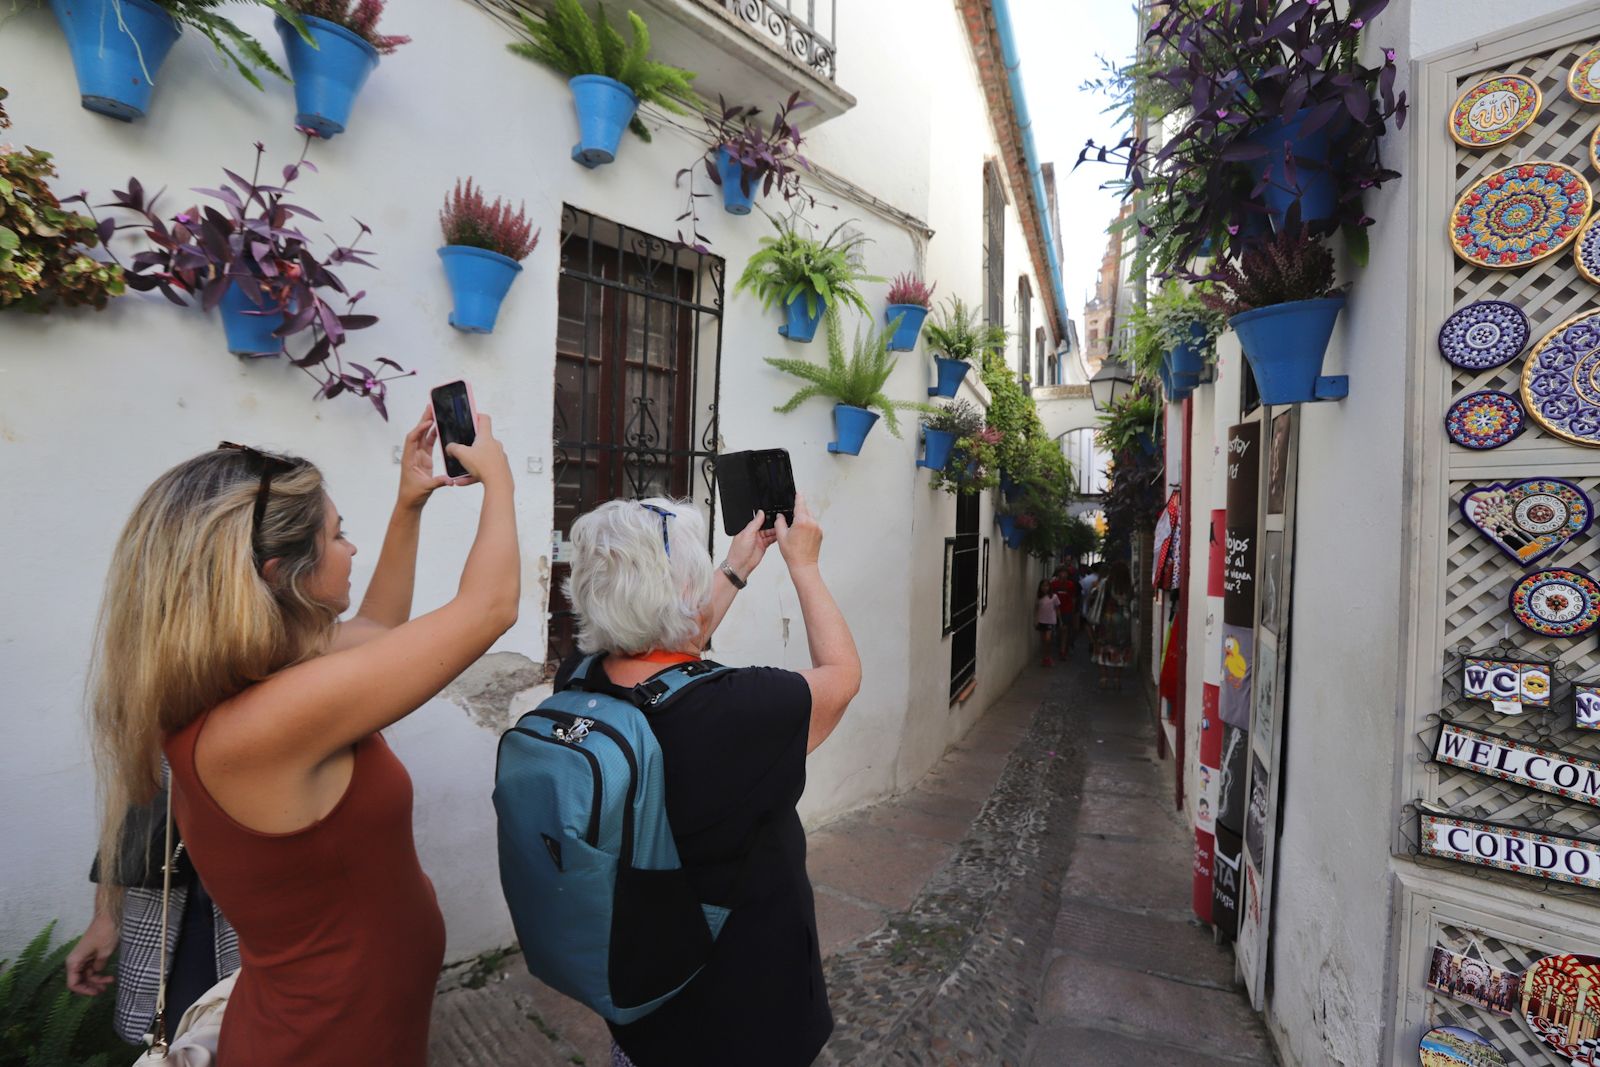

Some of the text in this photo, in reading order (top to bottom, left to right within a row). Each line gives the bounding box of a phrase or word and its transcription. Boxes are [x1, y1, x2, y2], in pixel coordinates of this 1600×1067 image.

[1466, 668, 1517, 692] WC
[1443, 732, 1600, 796] WELCOM
[1447, 828, 1600, 880] CORDO
